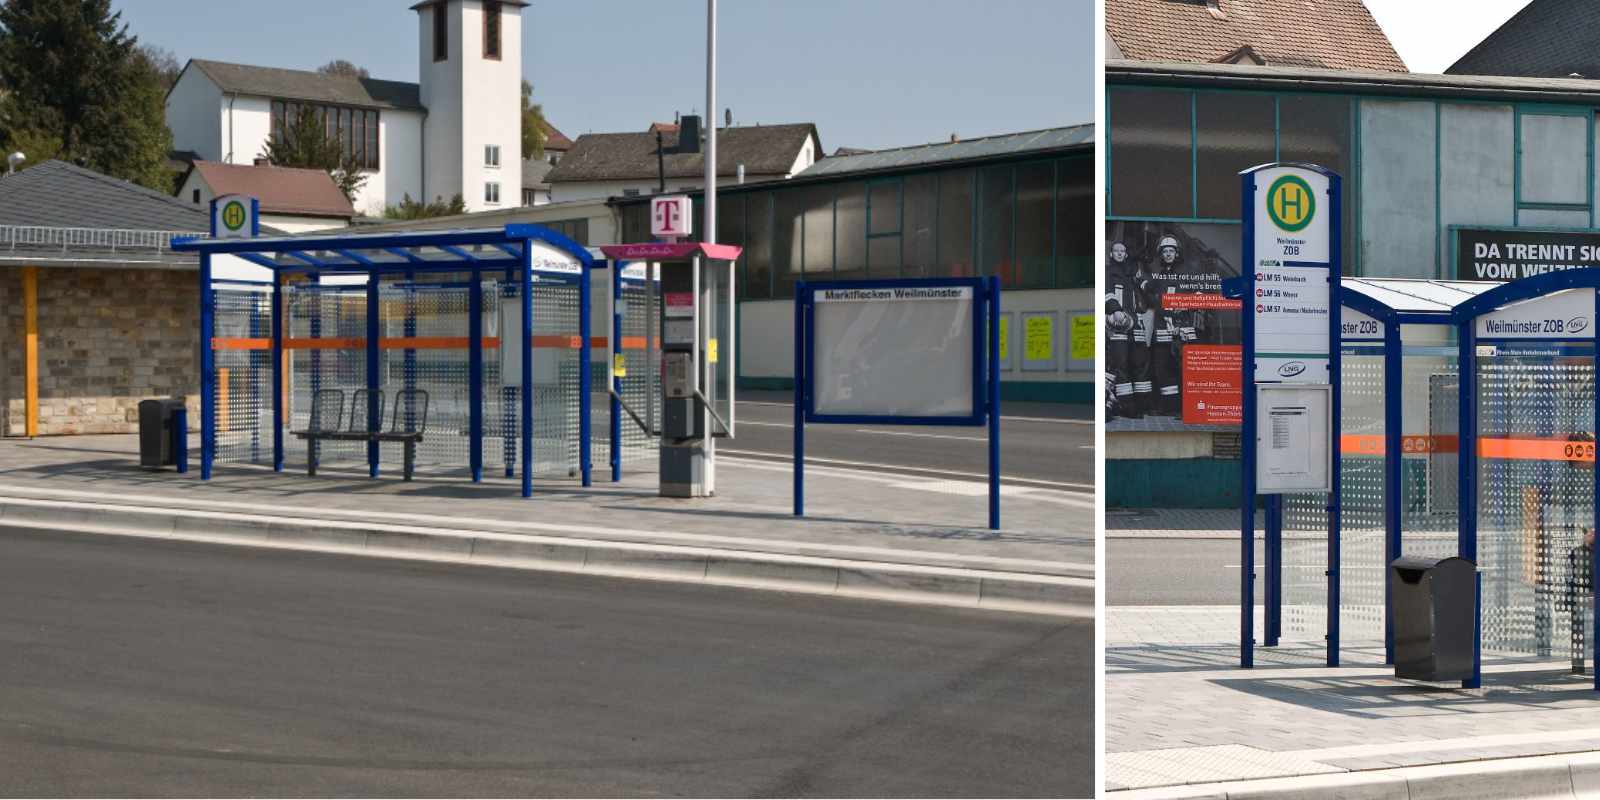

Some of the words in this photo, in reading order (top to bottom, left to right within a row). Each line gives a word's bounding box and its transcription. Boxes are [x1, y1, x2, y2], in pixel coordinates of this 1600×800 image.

[1282, 187, 1301, 219] H
[228, 207, 239, 224] H
[656, 200, 679, 231] T
[1283, 245, 1300, 256] ZOB
[1474, 242, 1501, 259] DA
[1505, 243, 1575, 261] TRENNT
[1151, 272, 1167, 280] Was
[1168, 272, 1177, 280] ist
[1190, 272, 1205, 281] und
[1264, 273, 1273, 282] LM
[1474, 262, 1517, 279] VOM
[825, 289, 891, 299] Marktflecken
[894, 287, 963, 298] Weilmünster
[1264, 289, 1273, 297] LM
[1264, 305, 1273, 313] LM
[1273, 305, 1281, 313] 57
[1341, 321, 1358, 334] ster
[1359, 320, 1378, 334] ZOB
[1486, 319, 1541, 333] Weilmünster
[1543, 319, 1564, 333] ZOB
